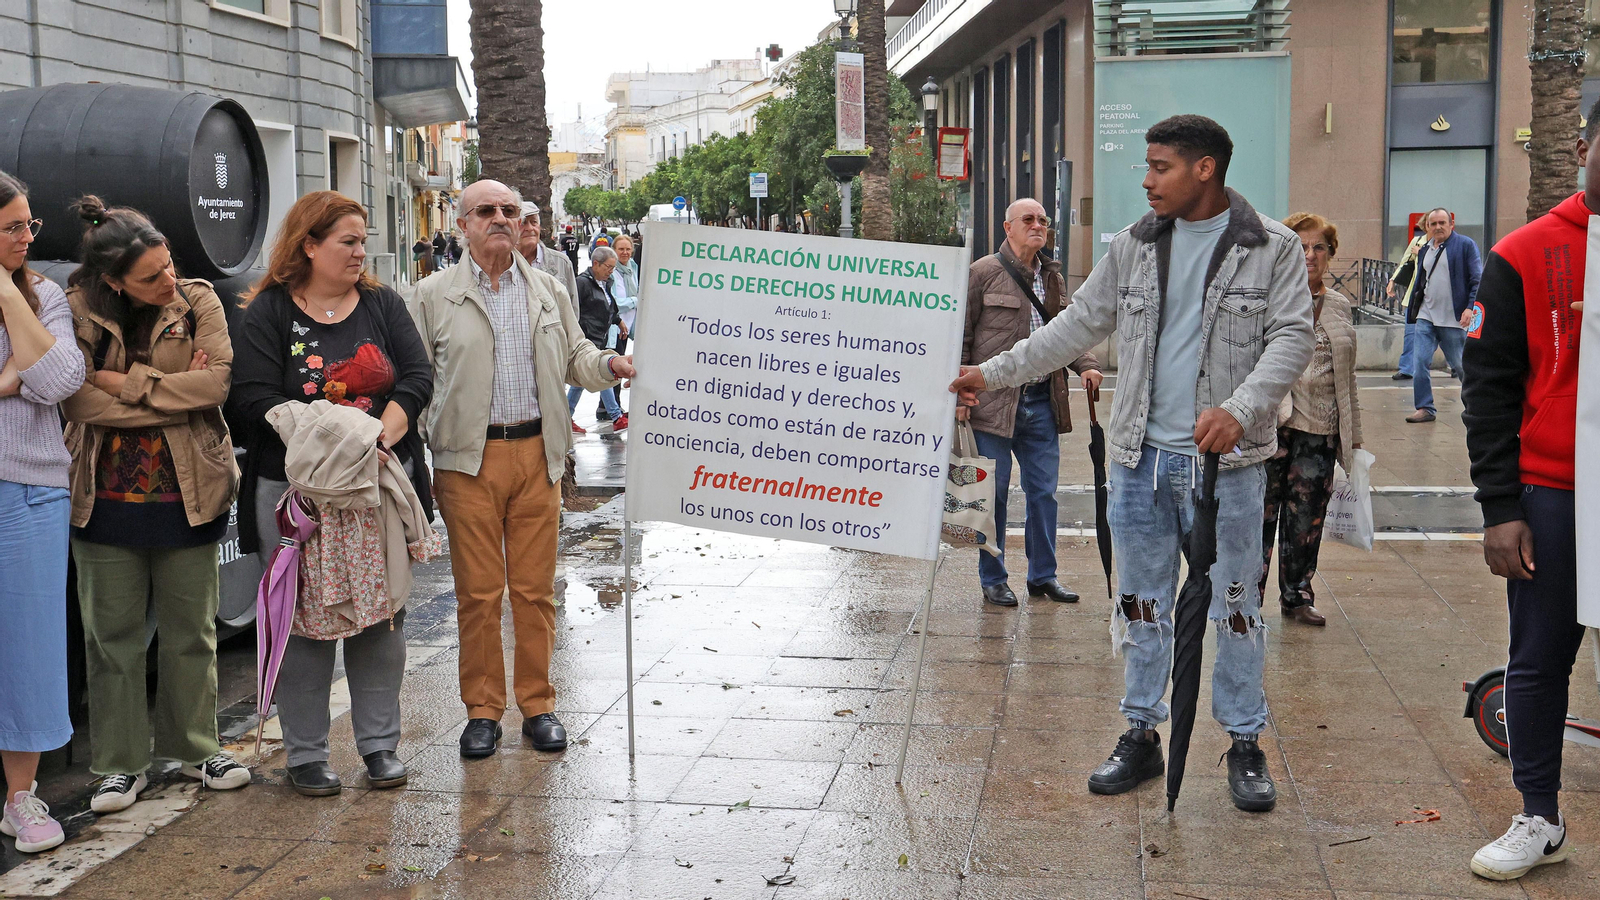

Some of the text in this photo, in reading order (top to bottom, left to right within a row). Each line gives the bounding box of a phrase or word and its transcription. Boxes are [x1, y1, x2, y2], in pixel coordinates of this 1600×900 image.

[198, 195, 244, 209] Ayuntamiento
[209, 209, 236, 221] de Jerez
[569, 243, 576, 251] 17
[681, 241, 939, 280] DECLARACIÓN UNIVERSAL
[1563, 244, 1573, 277] National
[657, 268, 958, 312] DE LOS DERECHOS HUMANOS:
[1546, 268, 1554, 293] Street
[1554, 246, 1567, 334] Space Administration
[775, 305, 831, 320] Artículo 1:
[748, 322, 775, 341] los
[780, 330, 830, 347] seres
[837, 330, 926, 356] humanos
[696, 351, 901, 383] nacen libres e iguales
[676, 377, 915, 419] en dignidad y derechos y,
[647, 400, 943, 452] dotados como están de razón y
[644, 432, 940, 478] conciencia, deben comportarse
[689, 465, 883, 507] fraternalmente
[681, 497, 704, 517] los
[711, 506, 754, 524] unos
[760, 513, 793, 528] con
[800, 512, 826, 532] los
